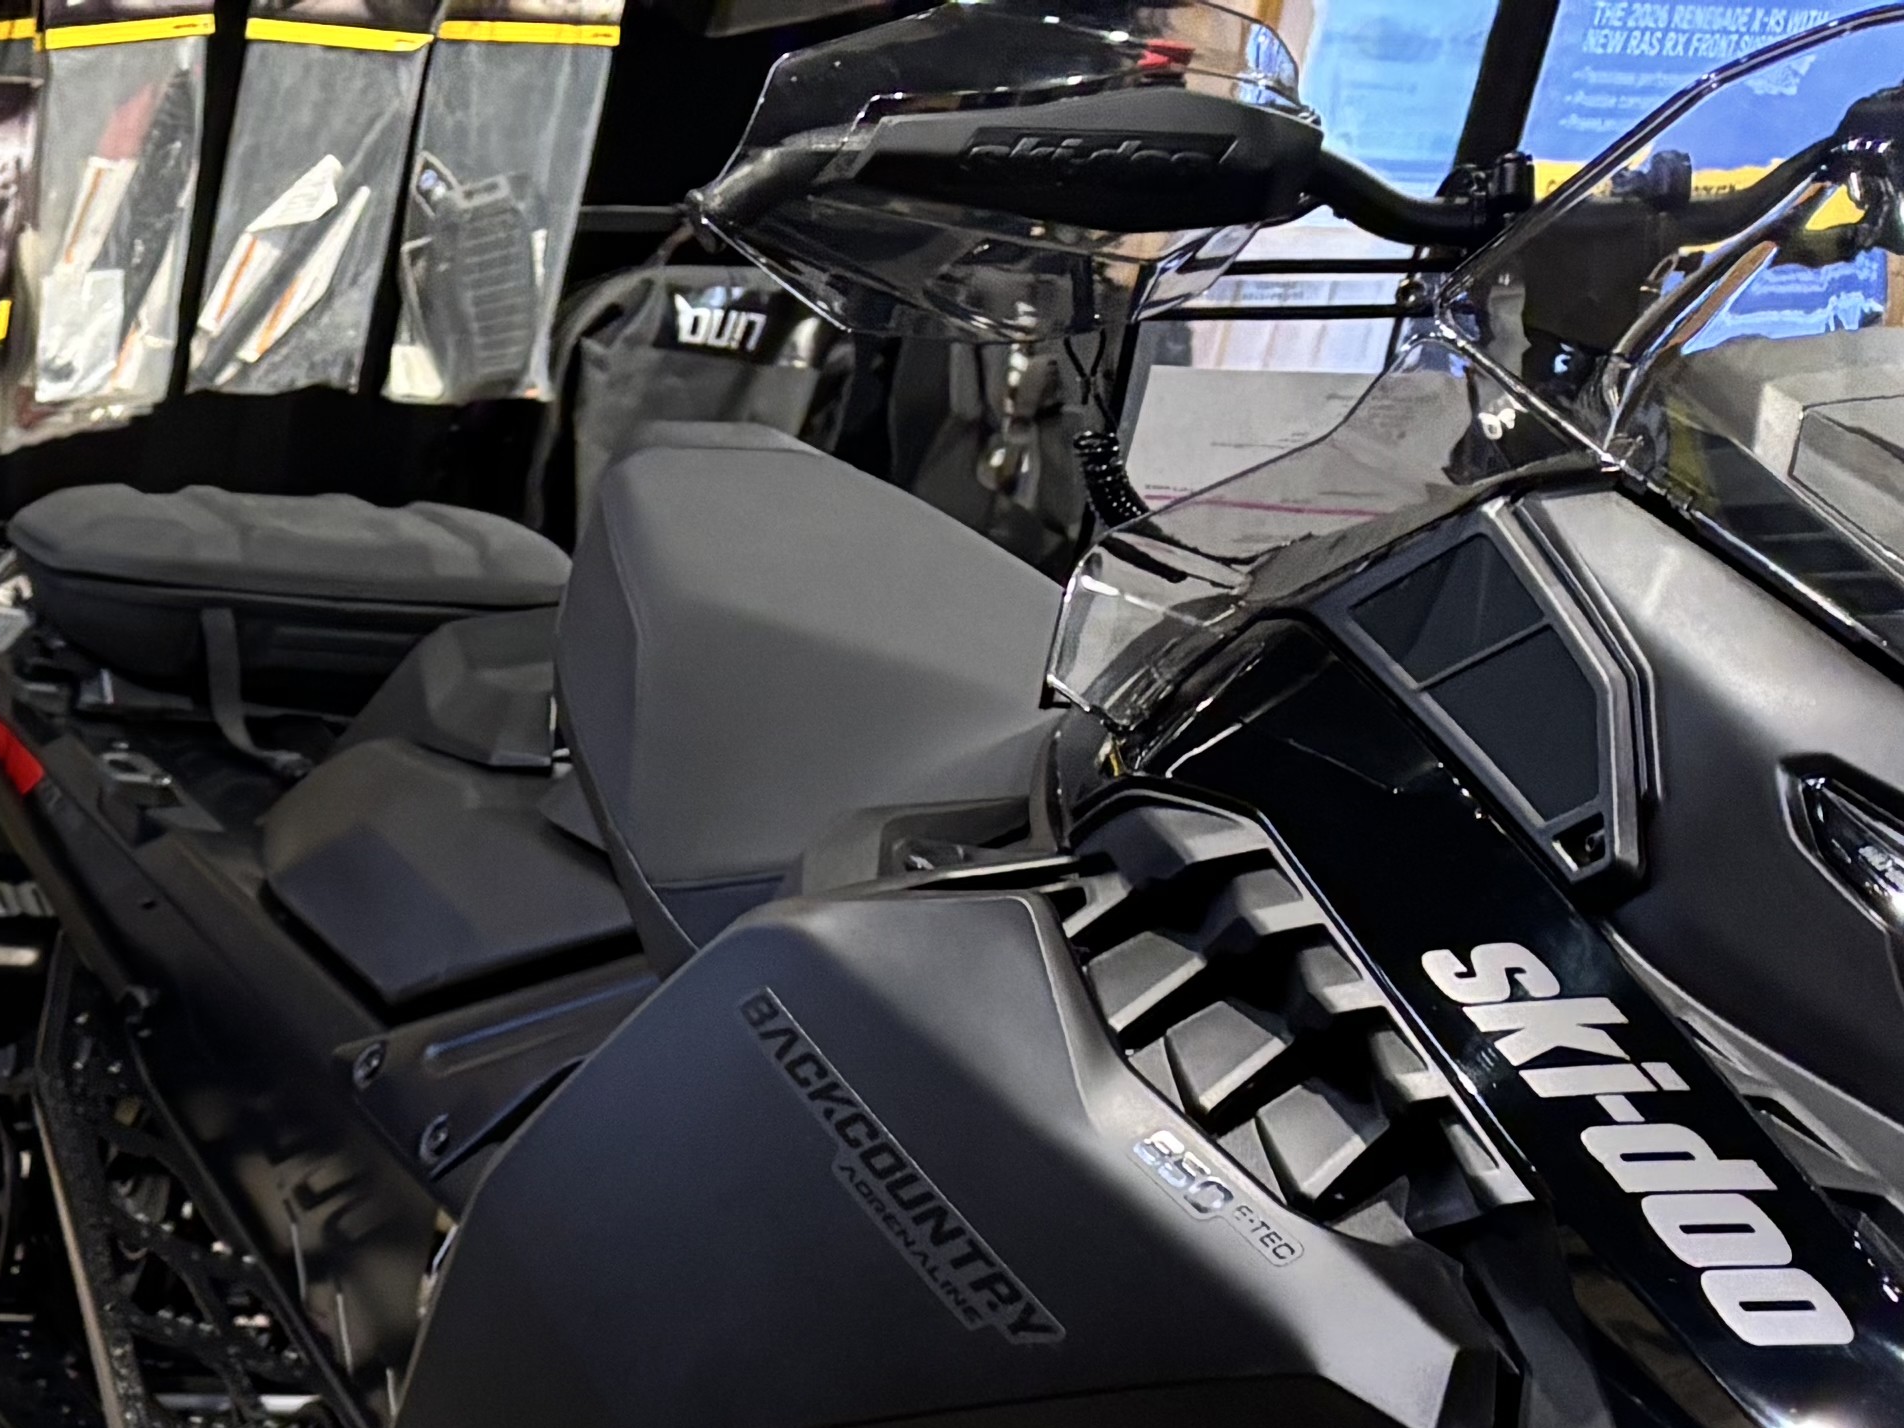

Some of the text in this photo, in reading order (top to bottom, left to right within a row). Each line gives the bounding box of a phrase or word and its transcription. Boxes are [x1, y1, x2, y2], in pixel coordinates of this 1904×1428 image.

[1583, 29, 1627, 55] NEW
[1626, 31, 1662, 56] RAS
[1662, 32, 1690, 57] RX
[1593, 1, 1628, 27] THE
[1671, 5, 1753, 31] RENEGADE
[741, 995, 1056, 1336] BACKCOUNTRY
[1133, 1130, 1295, 1260] 850 E-TEC
[1421, 942, 1855, 1346] ski-doo
[839, 1163, 985, 1324] ADRENALINE
